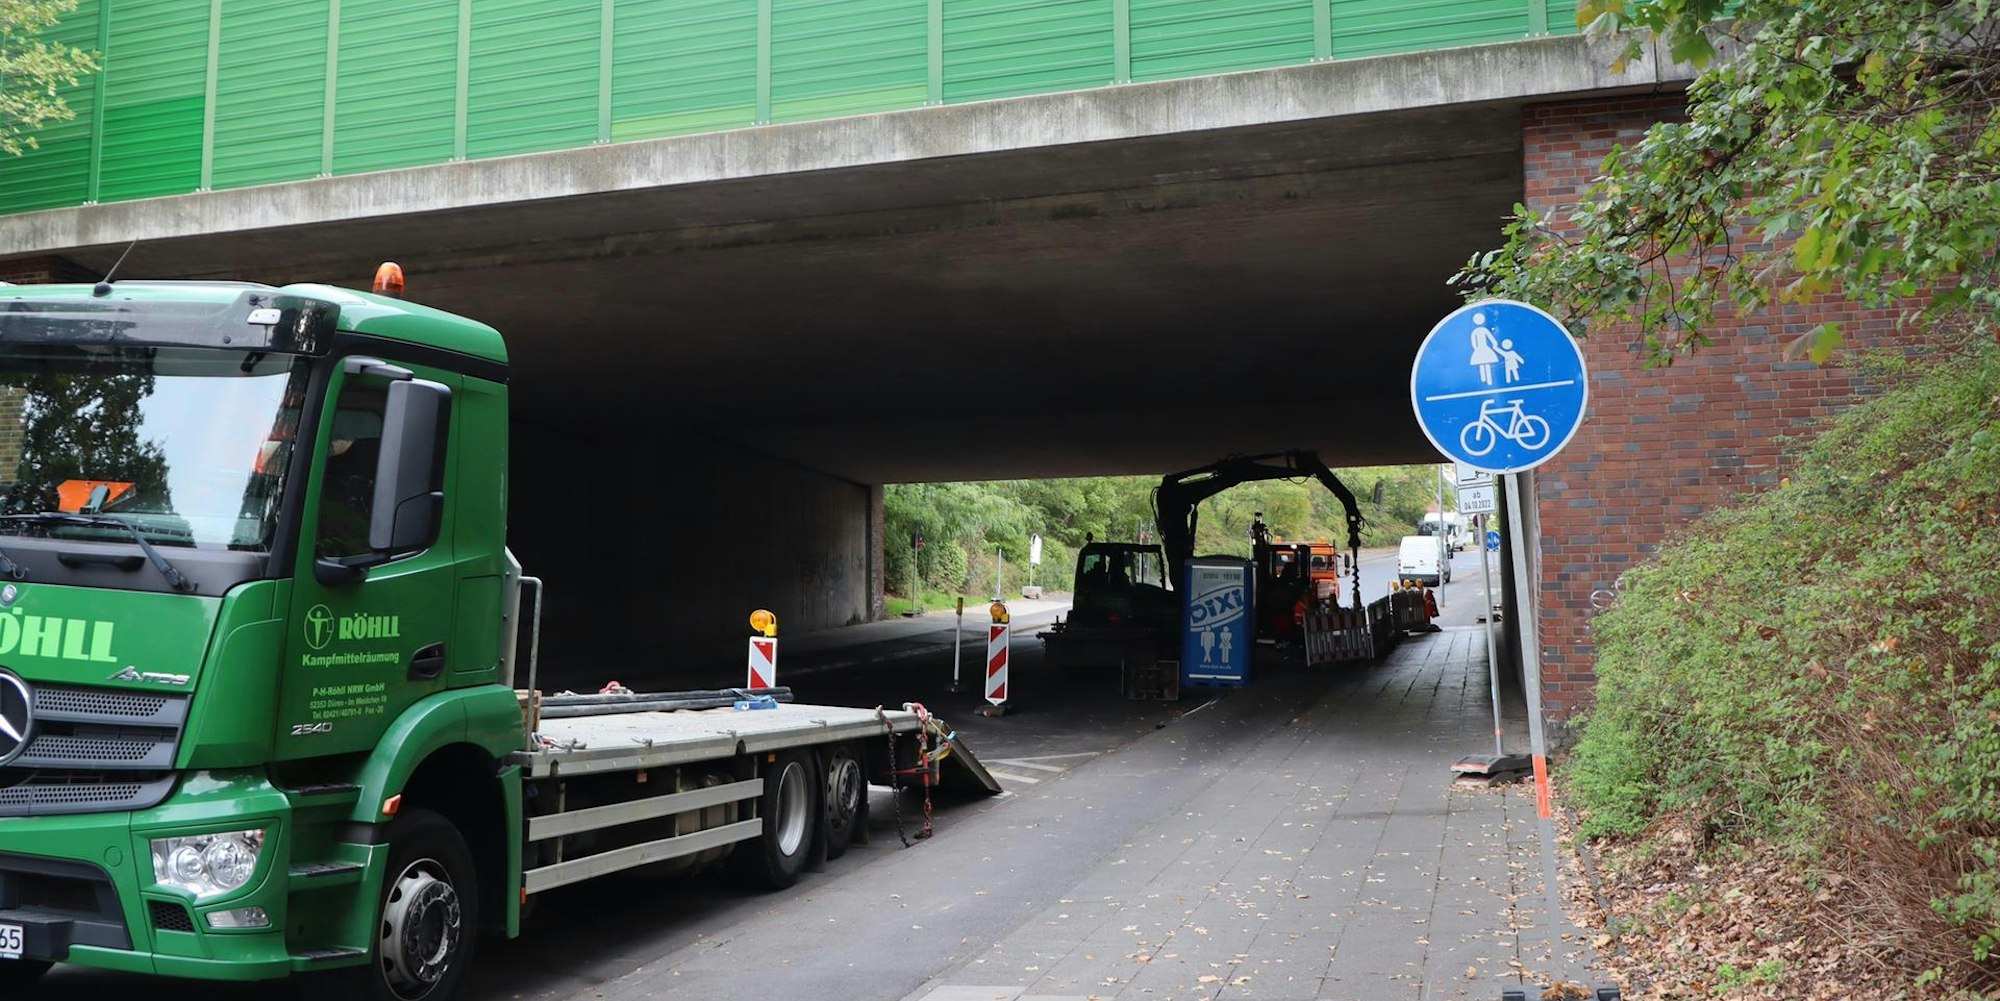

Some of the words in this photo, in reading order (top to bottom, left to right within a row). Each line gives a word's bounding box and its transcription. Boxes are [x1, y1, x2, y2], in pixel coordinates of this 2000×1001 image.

[1473, 491, 1481, 499] ab
[339, 612, 400, 640] RÖHLL
[302, 651, 400, 668] Kampfmittelräumung
[347, 684, 364, 694] NRW
[365, 682, 385, 693] GmbH
[291, 722, 332, 736] 2540
